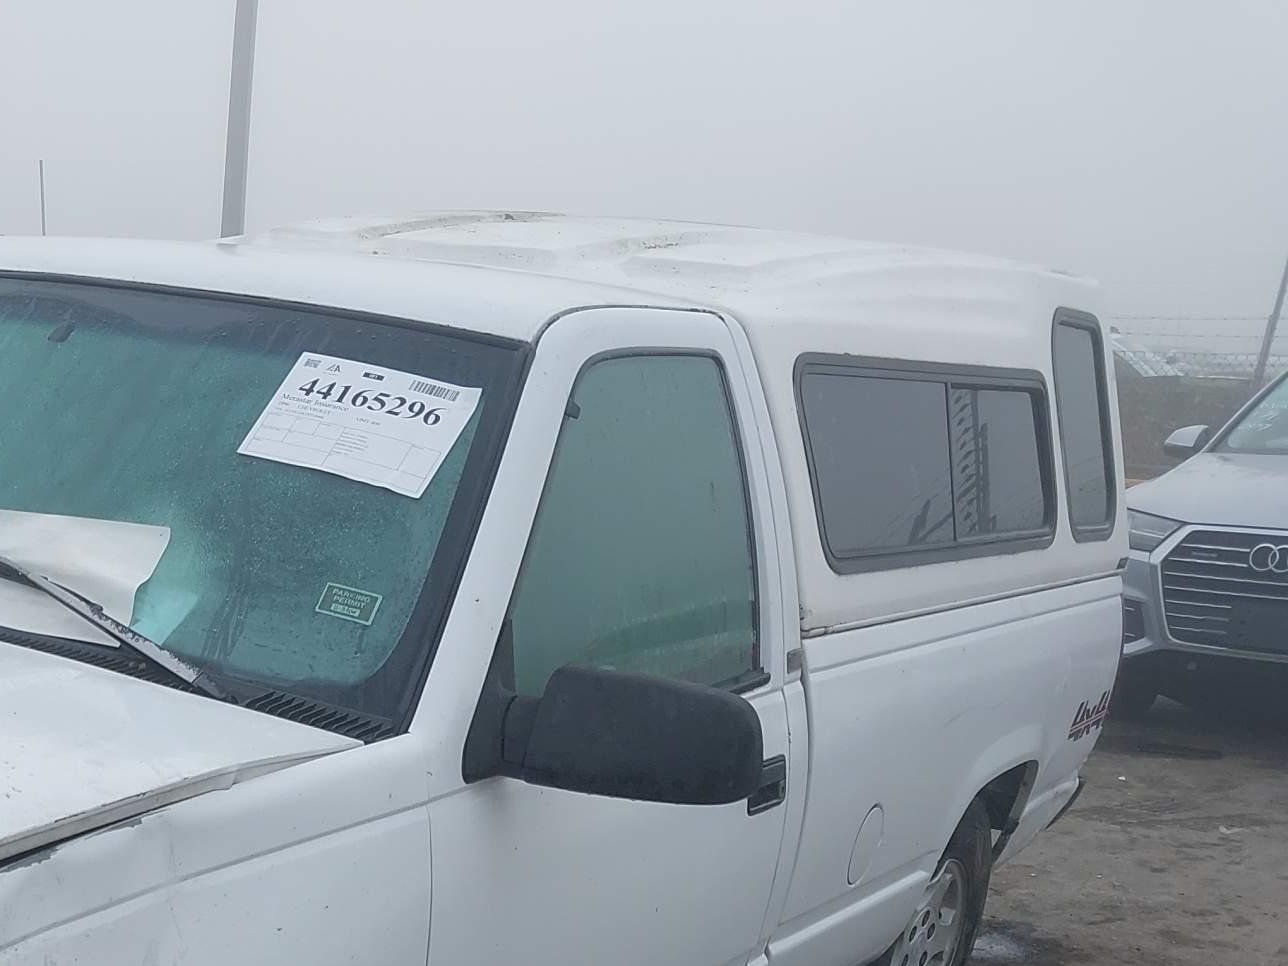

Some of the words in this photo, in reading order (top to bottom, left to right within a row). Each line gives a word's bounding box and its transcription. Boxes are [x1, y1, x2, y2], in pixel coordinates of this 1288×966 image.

[297, 376, 448, 426] 44165296
[314, 399, 350, 412] Insurance
[332, 595, 367, 609] PERMIT
